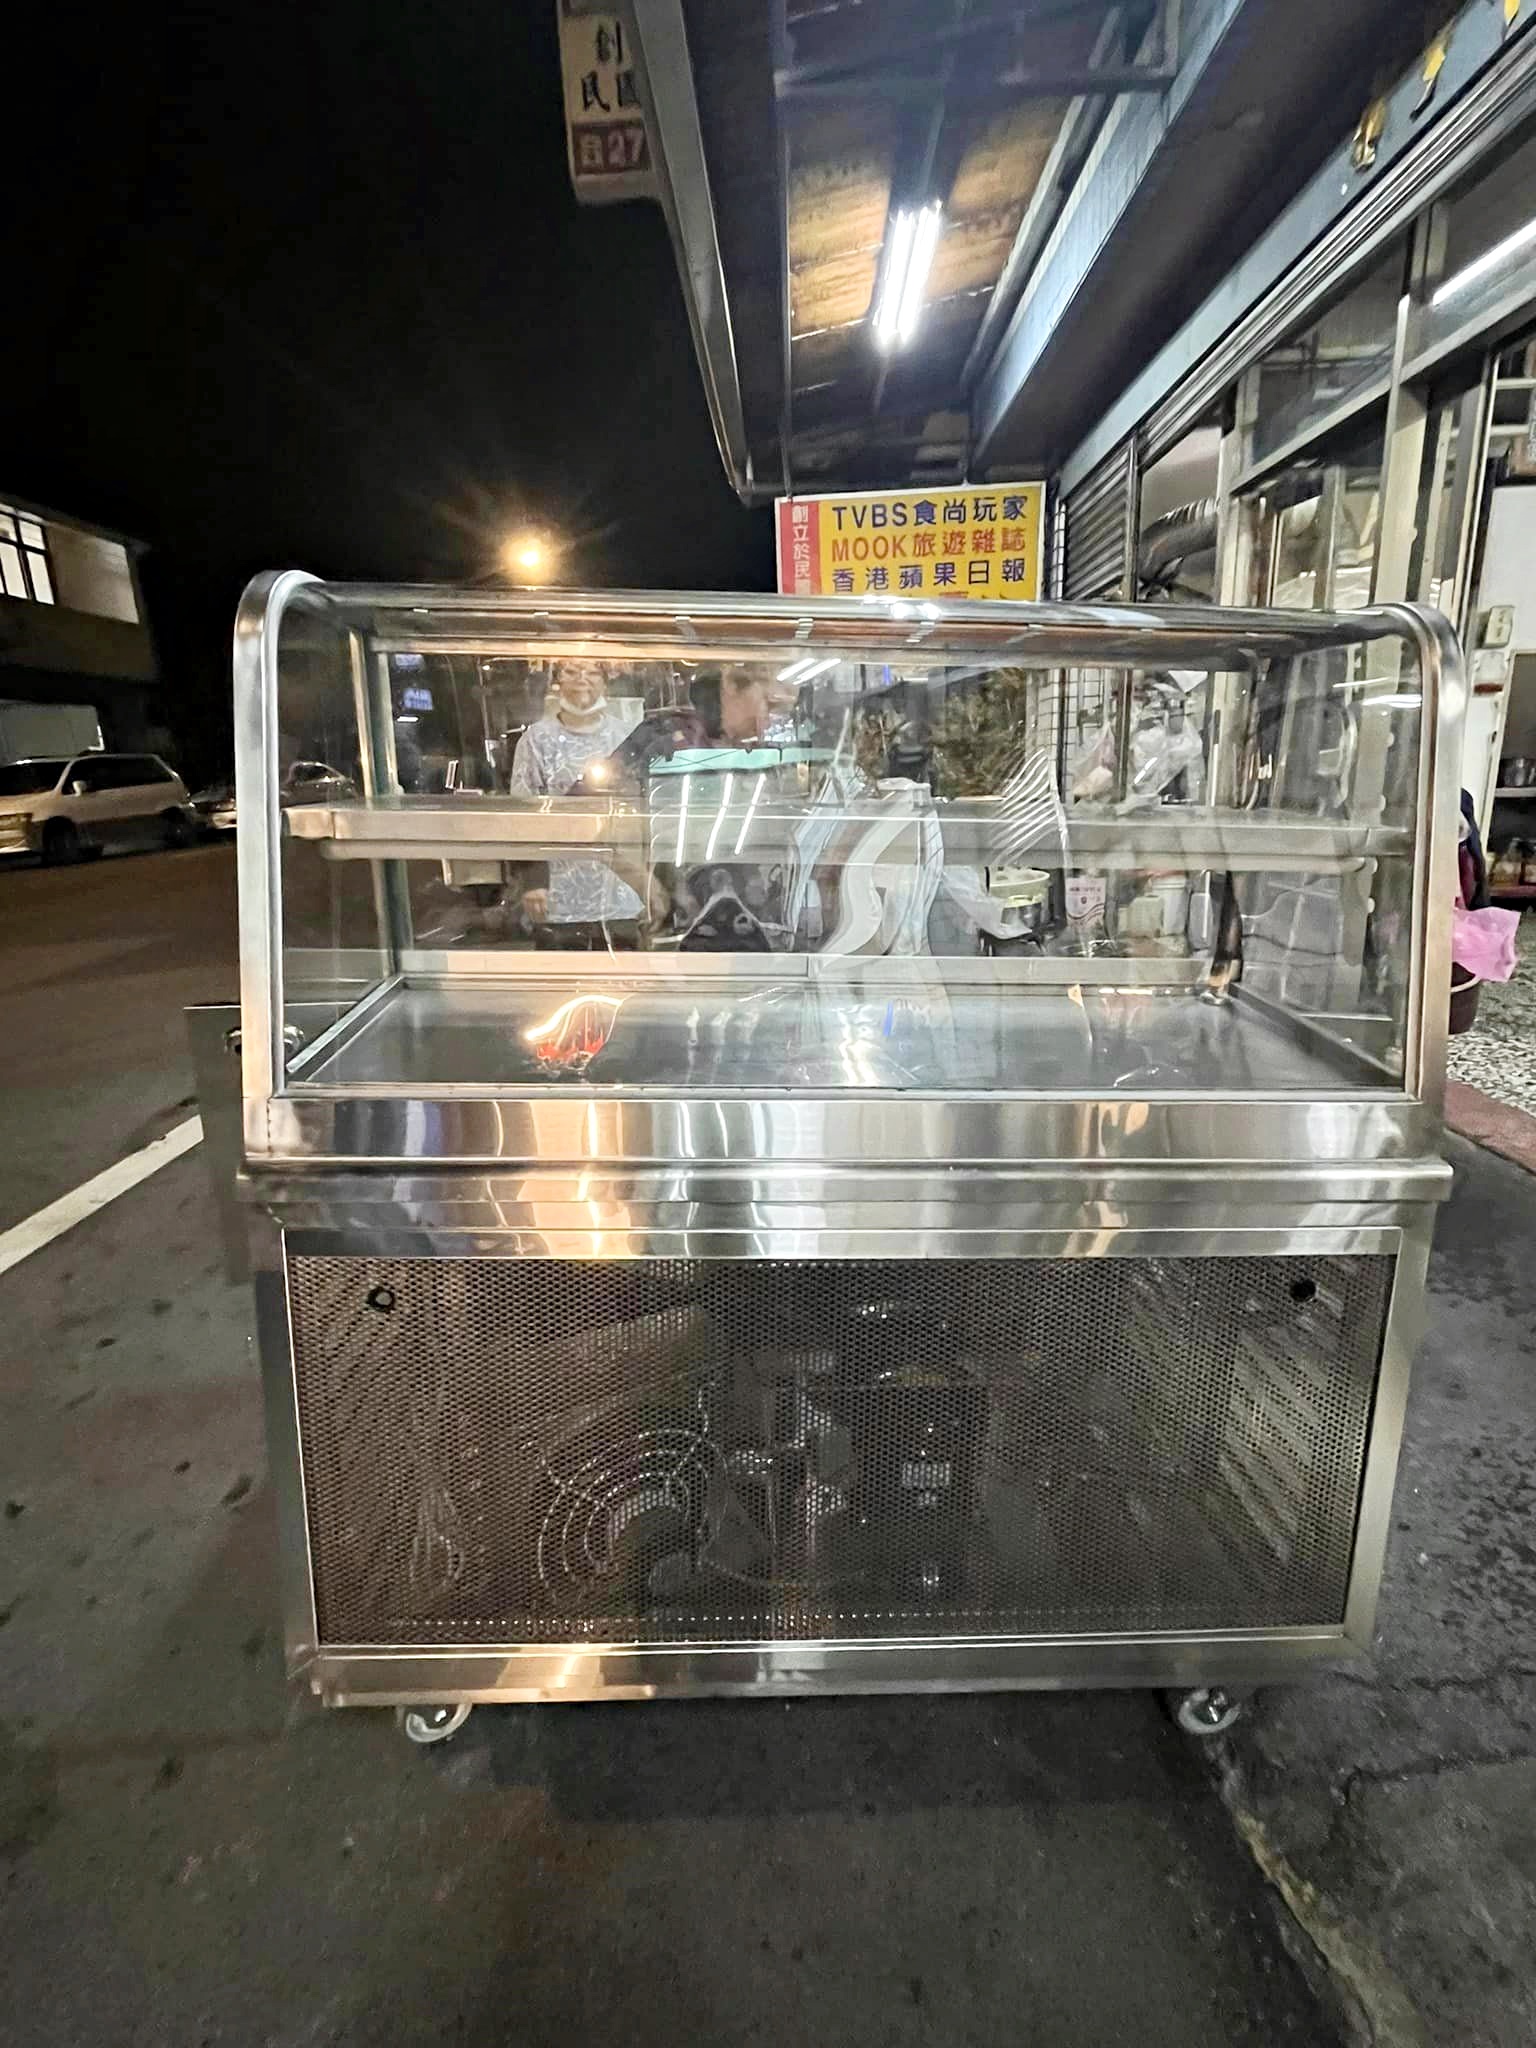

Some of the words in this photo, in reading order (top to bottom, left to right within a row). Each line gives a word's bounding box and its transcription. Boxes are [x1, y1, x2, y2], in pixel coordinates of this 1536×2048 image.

[832, 495, 1028, 531] TVBS食尚玩家
[832, 527, 1026, 562] MOOK旅遊雜誌
[833, 558, 1025, 593] 香港蘋果日報
